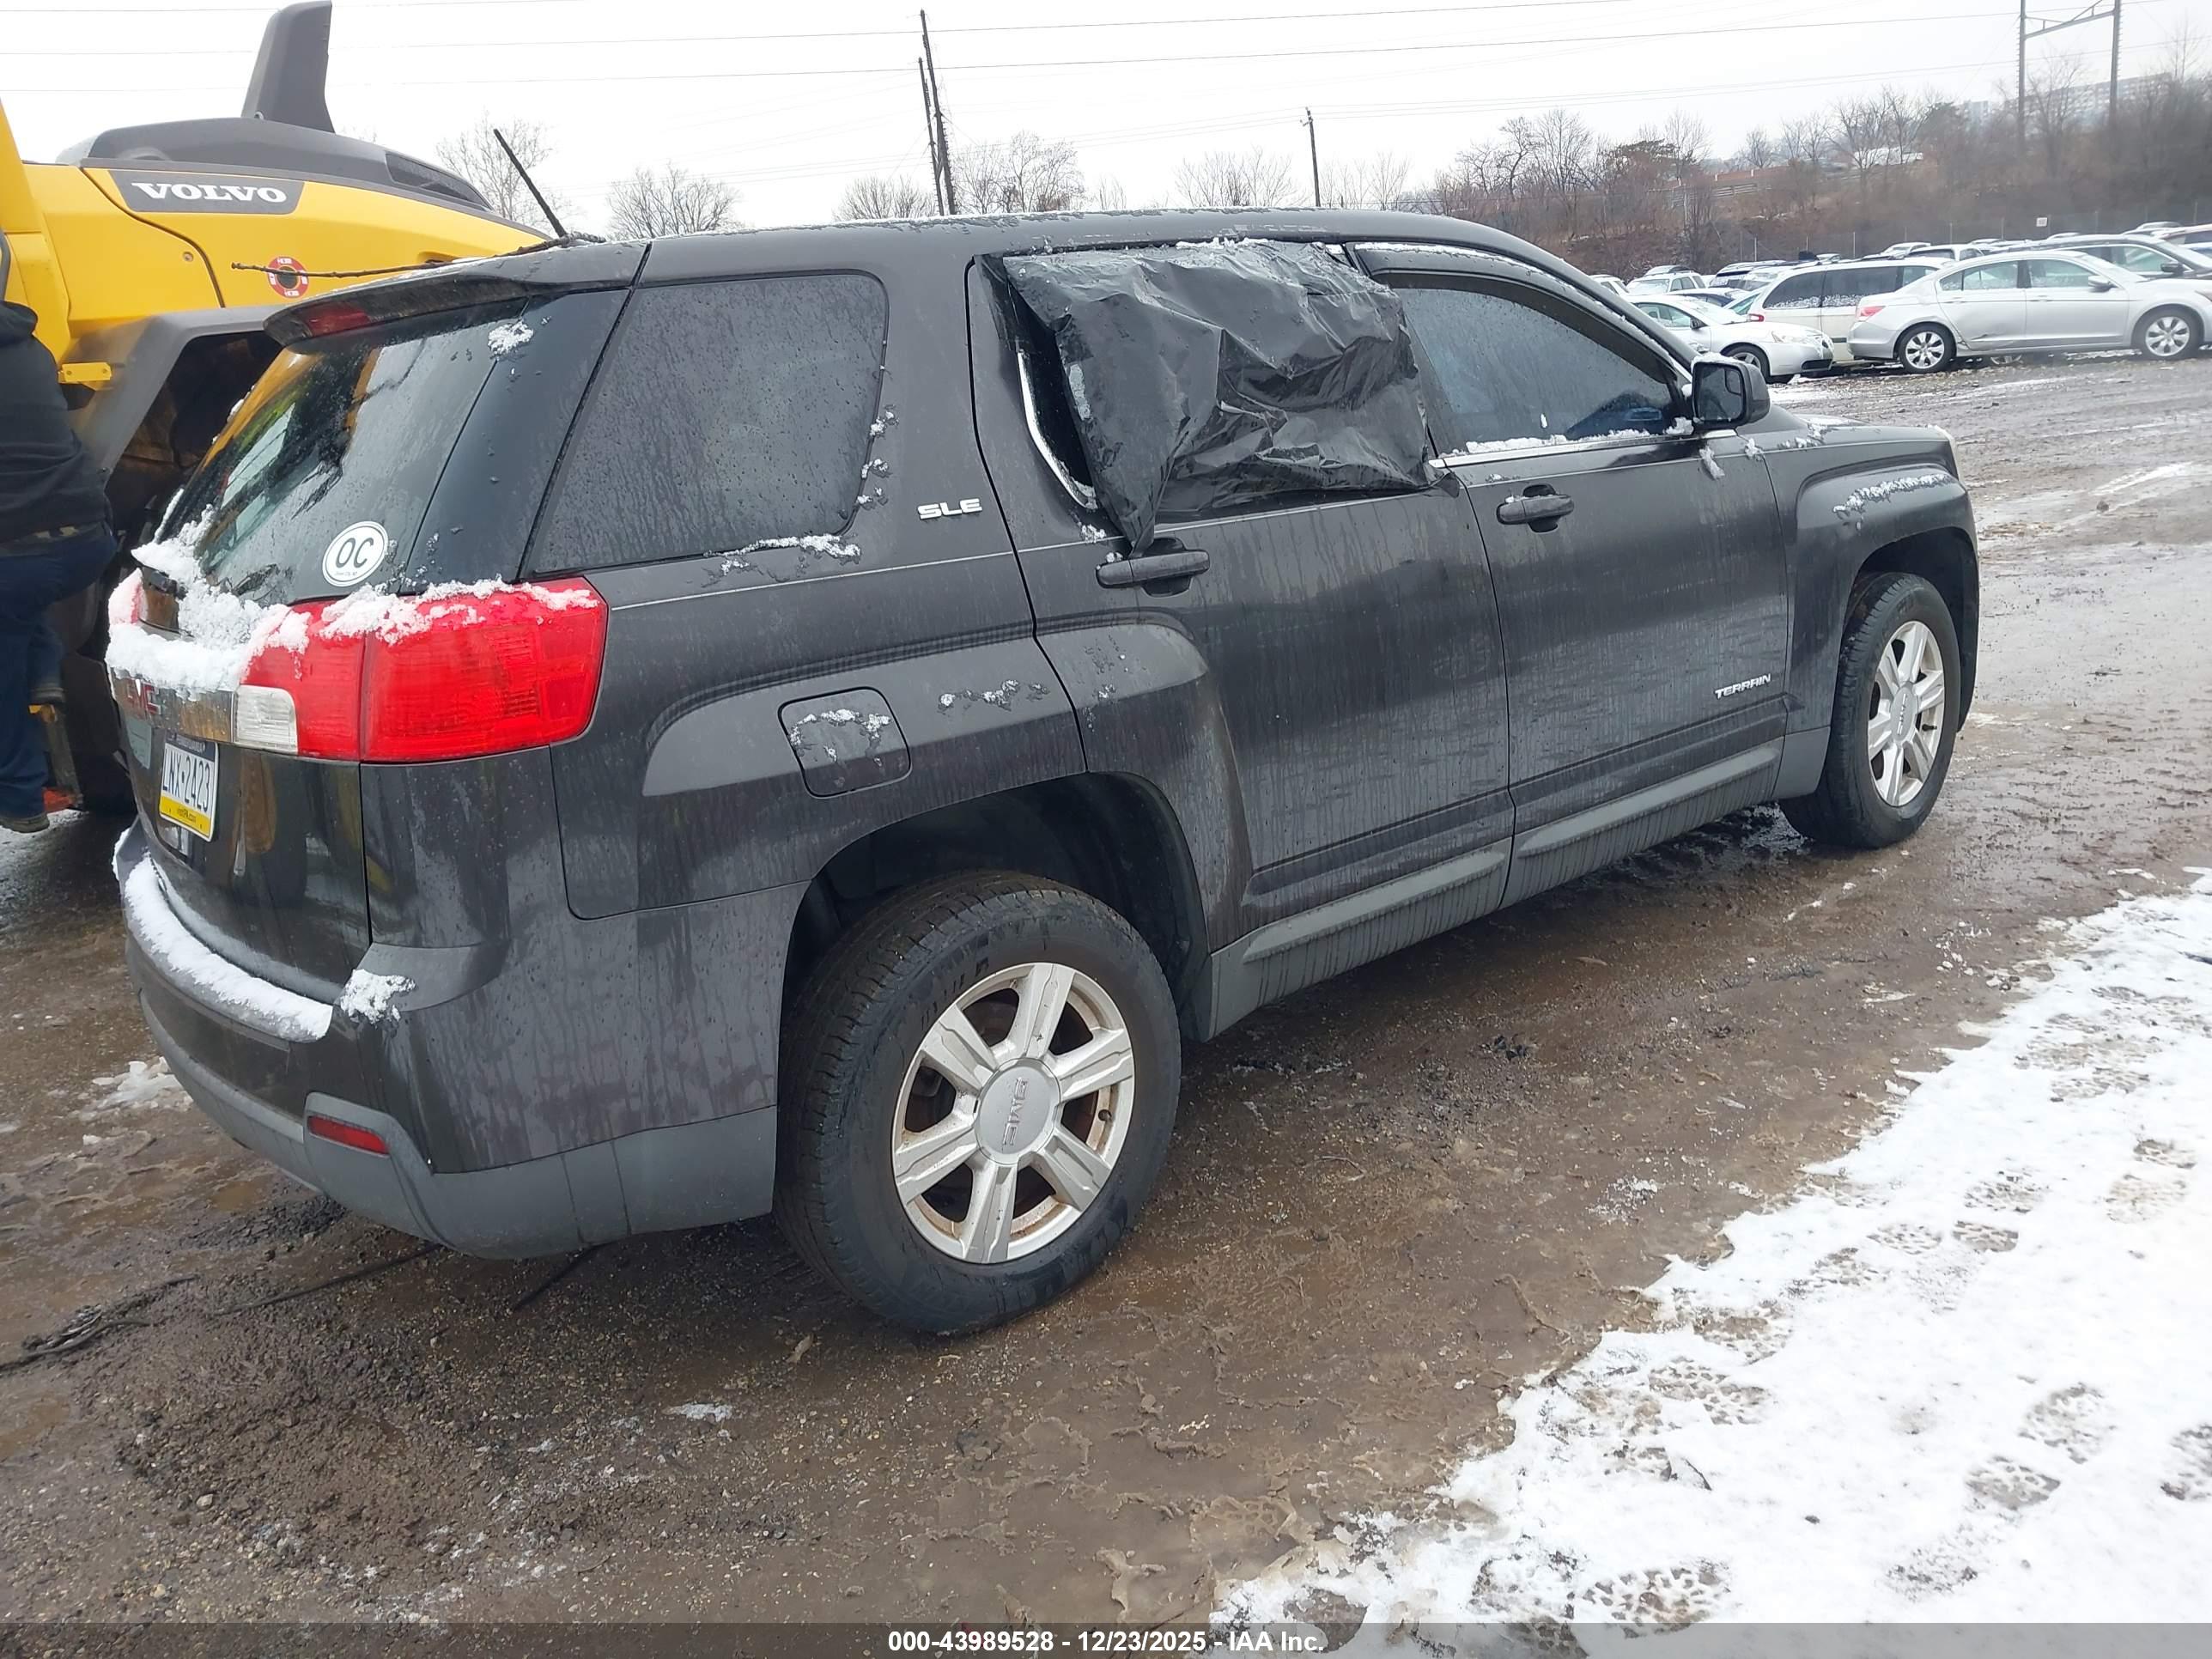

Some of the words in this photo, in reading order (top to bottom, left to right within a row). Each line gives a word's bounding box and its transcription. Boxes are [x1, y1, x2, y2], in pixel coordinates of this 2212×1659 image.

[131, 183, 287, 203] VOLVO
[918, 498, 982, 519] SLE
[336, 537, 374, 568] OC
[1715, 673, 1771, 699] TERRAIN
